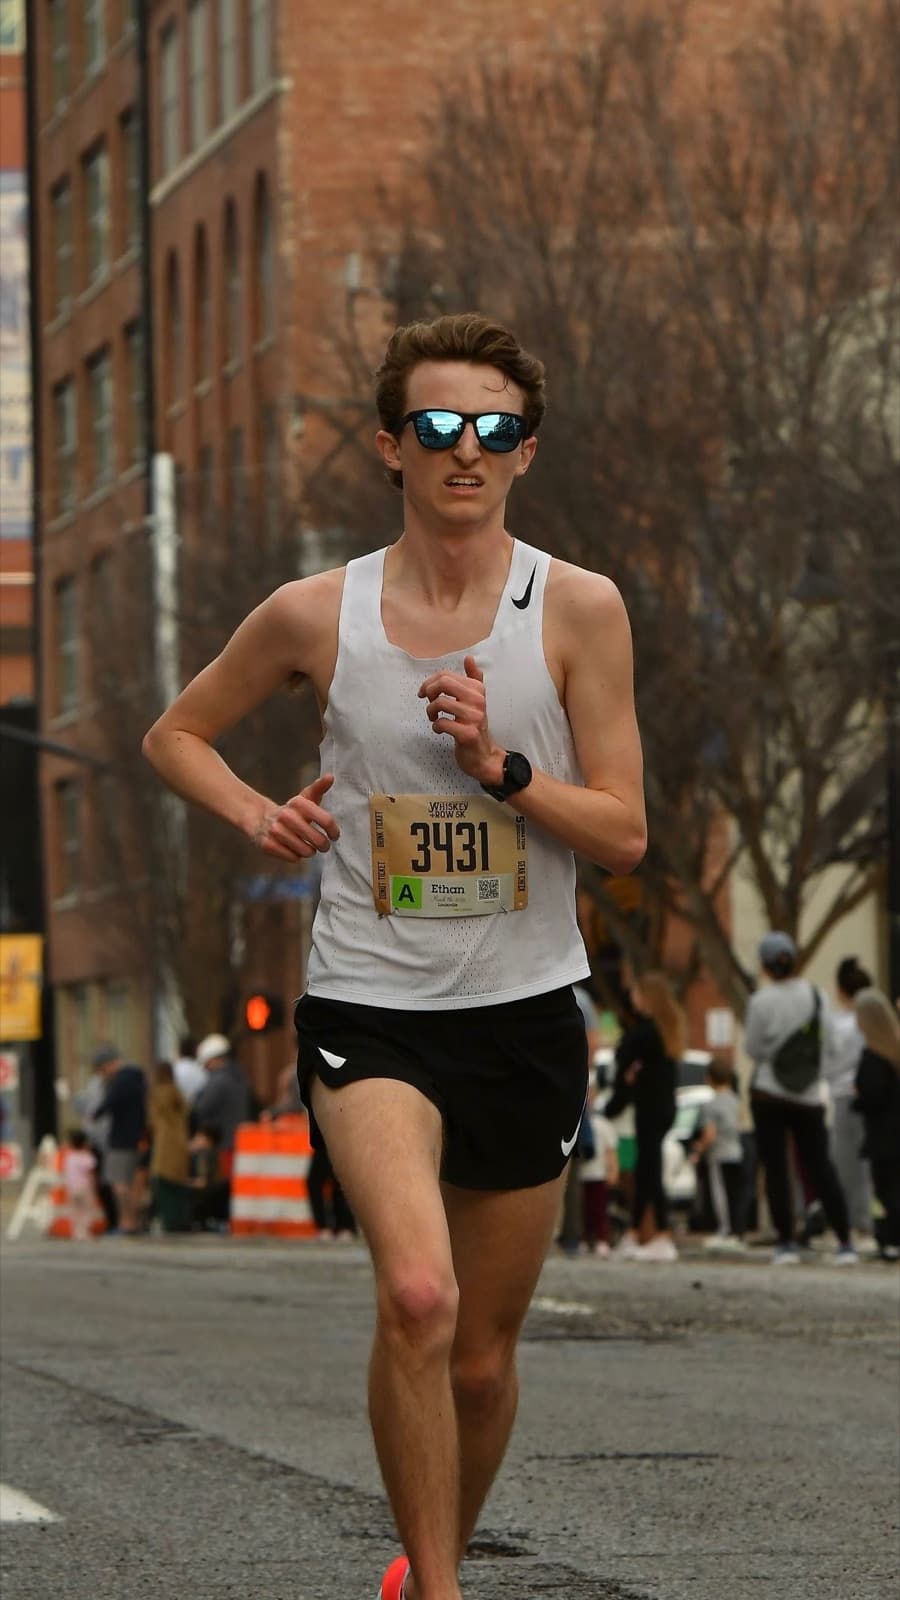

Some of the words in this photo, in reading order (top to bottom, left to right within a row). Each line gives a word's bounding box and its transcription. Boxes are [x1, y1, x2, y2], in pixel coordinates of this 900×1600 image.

[429, 801, 469, 812] WHISKEY
[410, 822, 489, 873] 3431
[398, 884, 415, 902] A
[431, 884, 465, 894] Ethan
